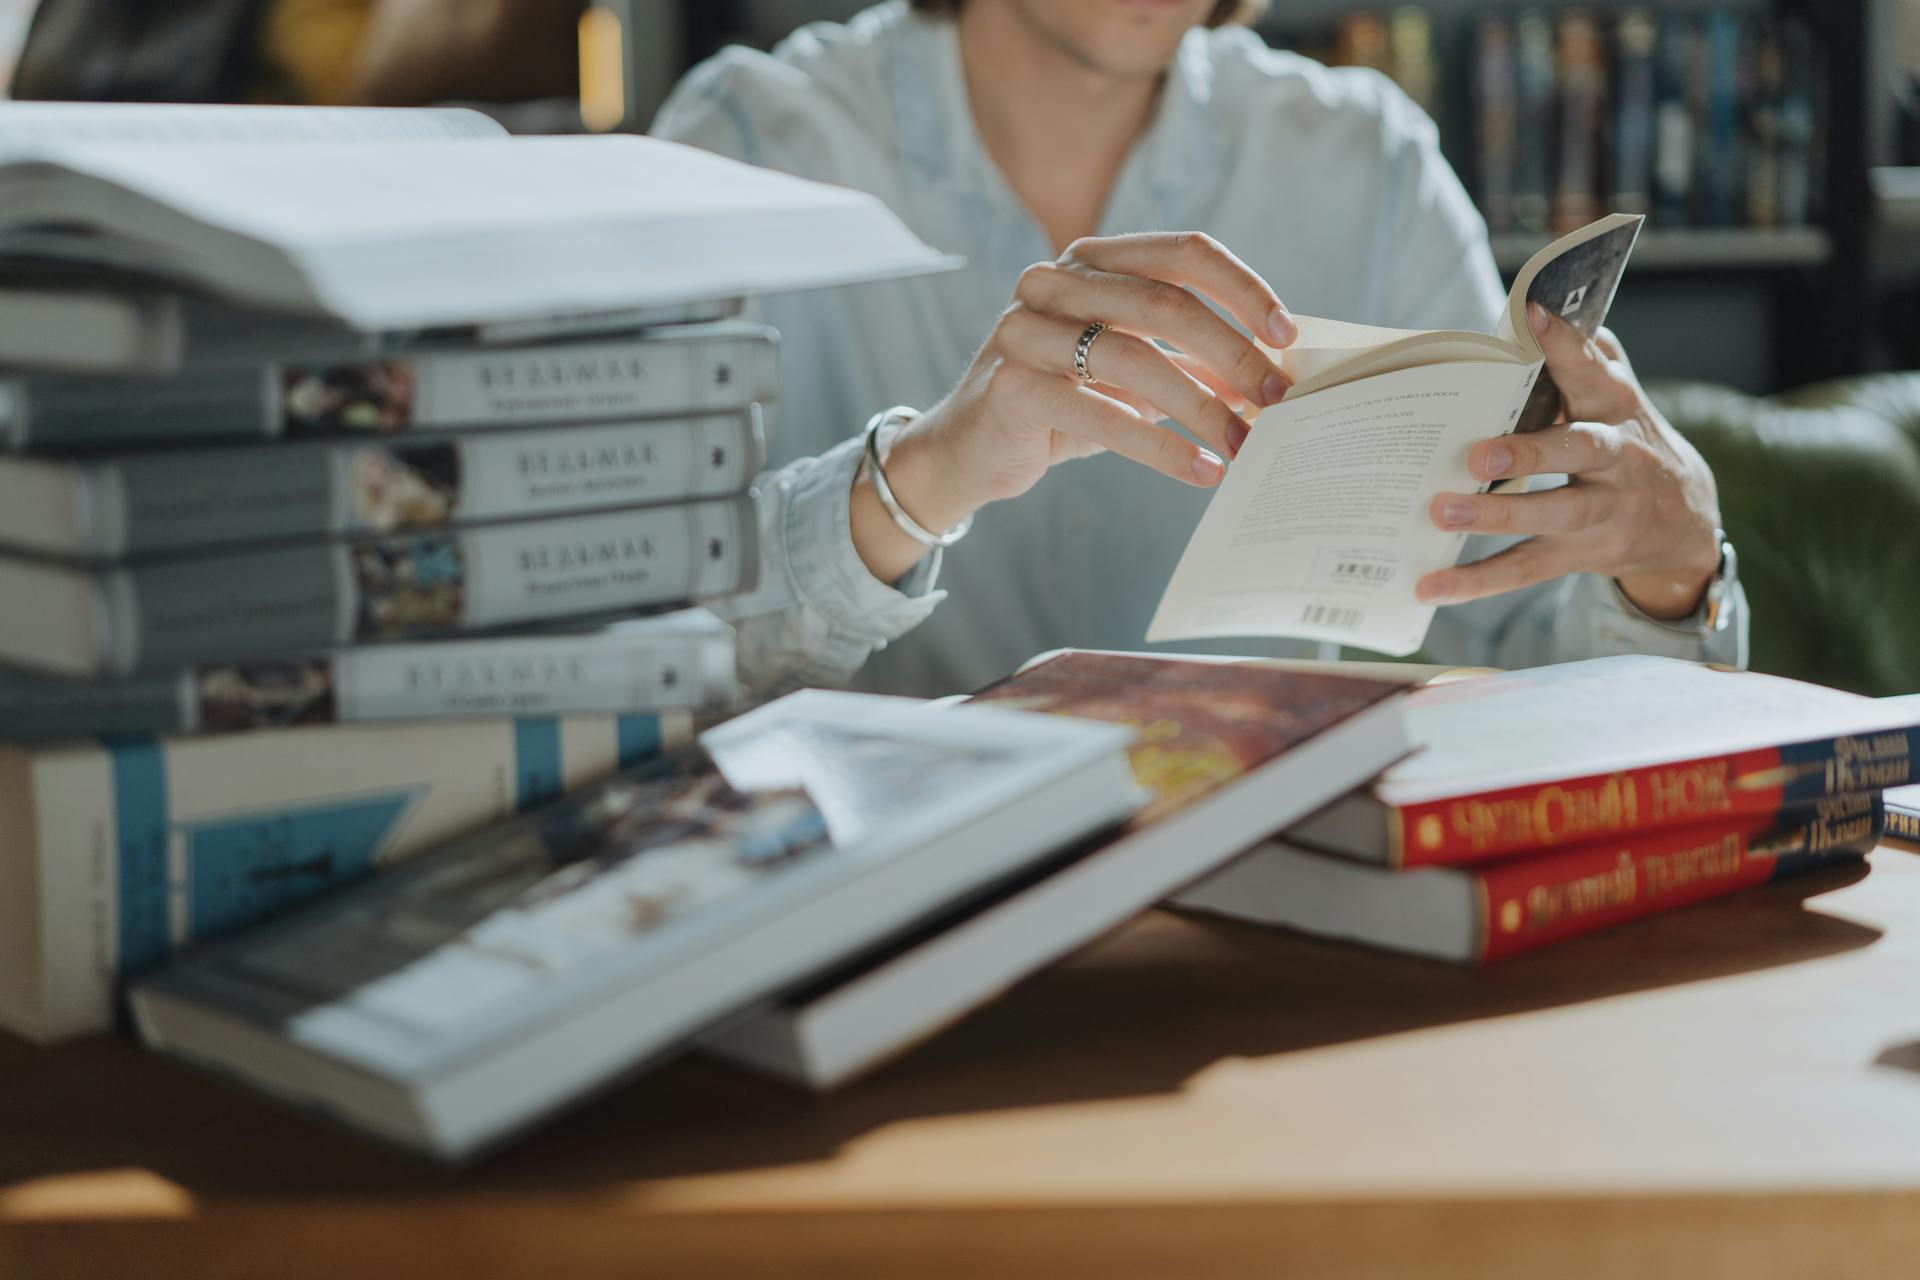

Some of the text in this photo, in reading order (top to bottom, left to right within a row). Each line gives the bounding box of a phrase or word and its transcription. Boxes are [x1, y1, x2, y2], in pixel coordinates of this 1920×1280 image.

[478, 357, 648, 388] ВЕДЬМАК
[1433, 390, 1460, 398] POCHE
[519, 442, 658, 475] ВЕДЬМАК
[519, 536, 658, 571] ВЕДЬМАК
[407, 657, 590, 688] ВЕДЬМАК
[1649, 760, 1732, 821] НОЖ
